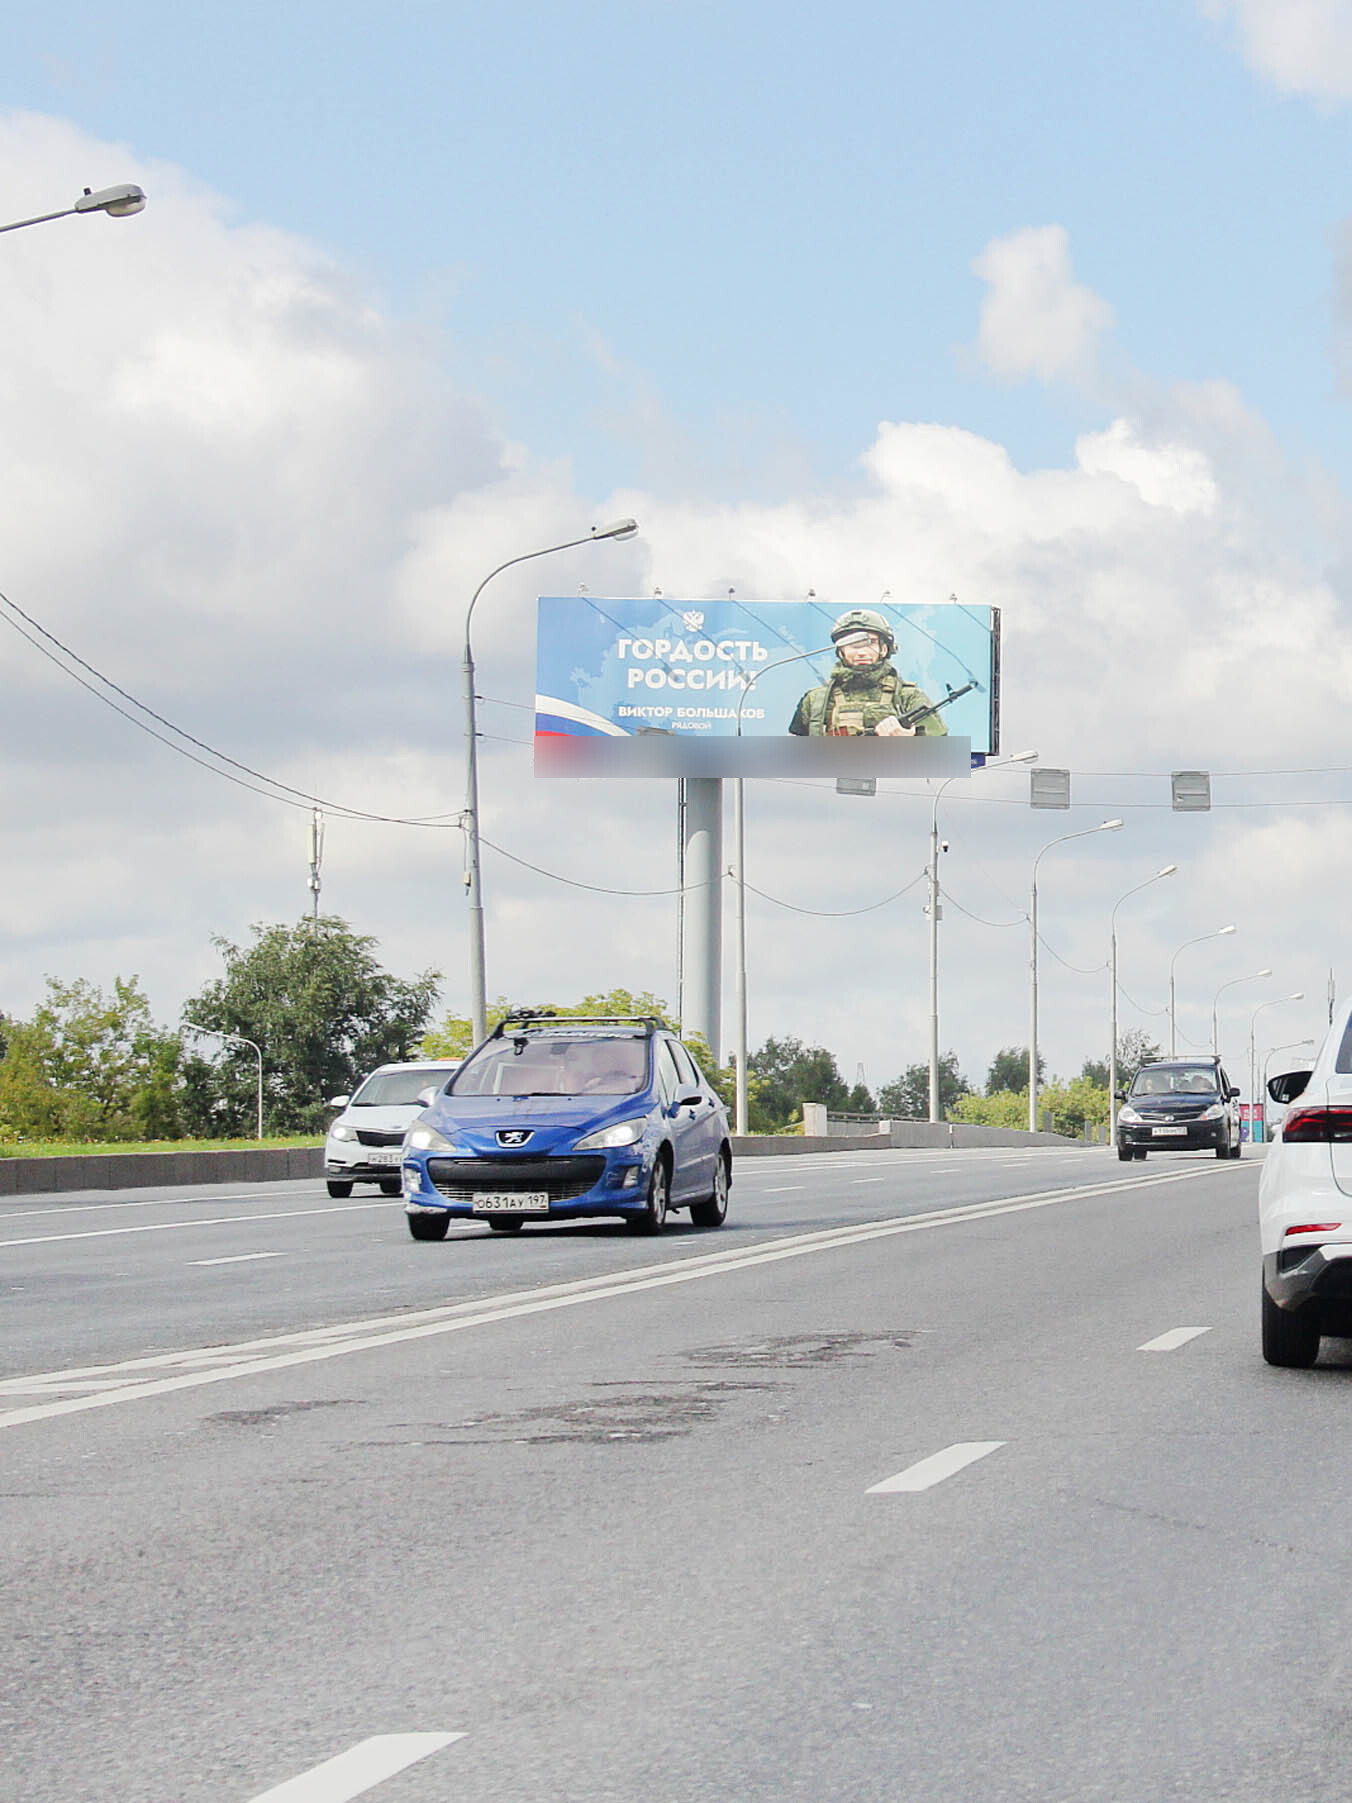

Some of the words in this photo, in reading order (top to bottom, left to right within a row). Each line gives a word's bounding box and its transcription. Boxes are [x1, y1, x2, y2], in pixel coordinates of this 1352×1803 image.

[617, 639, 769, 663] ГОРДОСТЬ
[618, 706, 673, 717] ВИКТОР
[677, 707, 765, 719] БОЛЬШАКОВ
